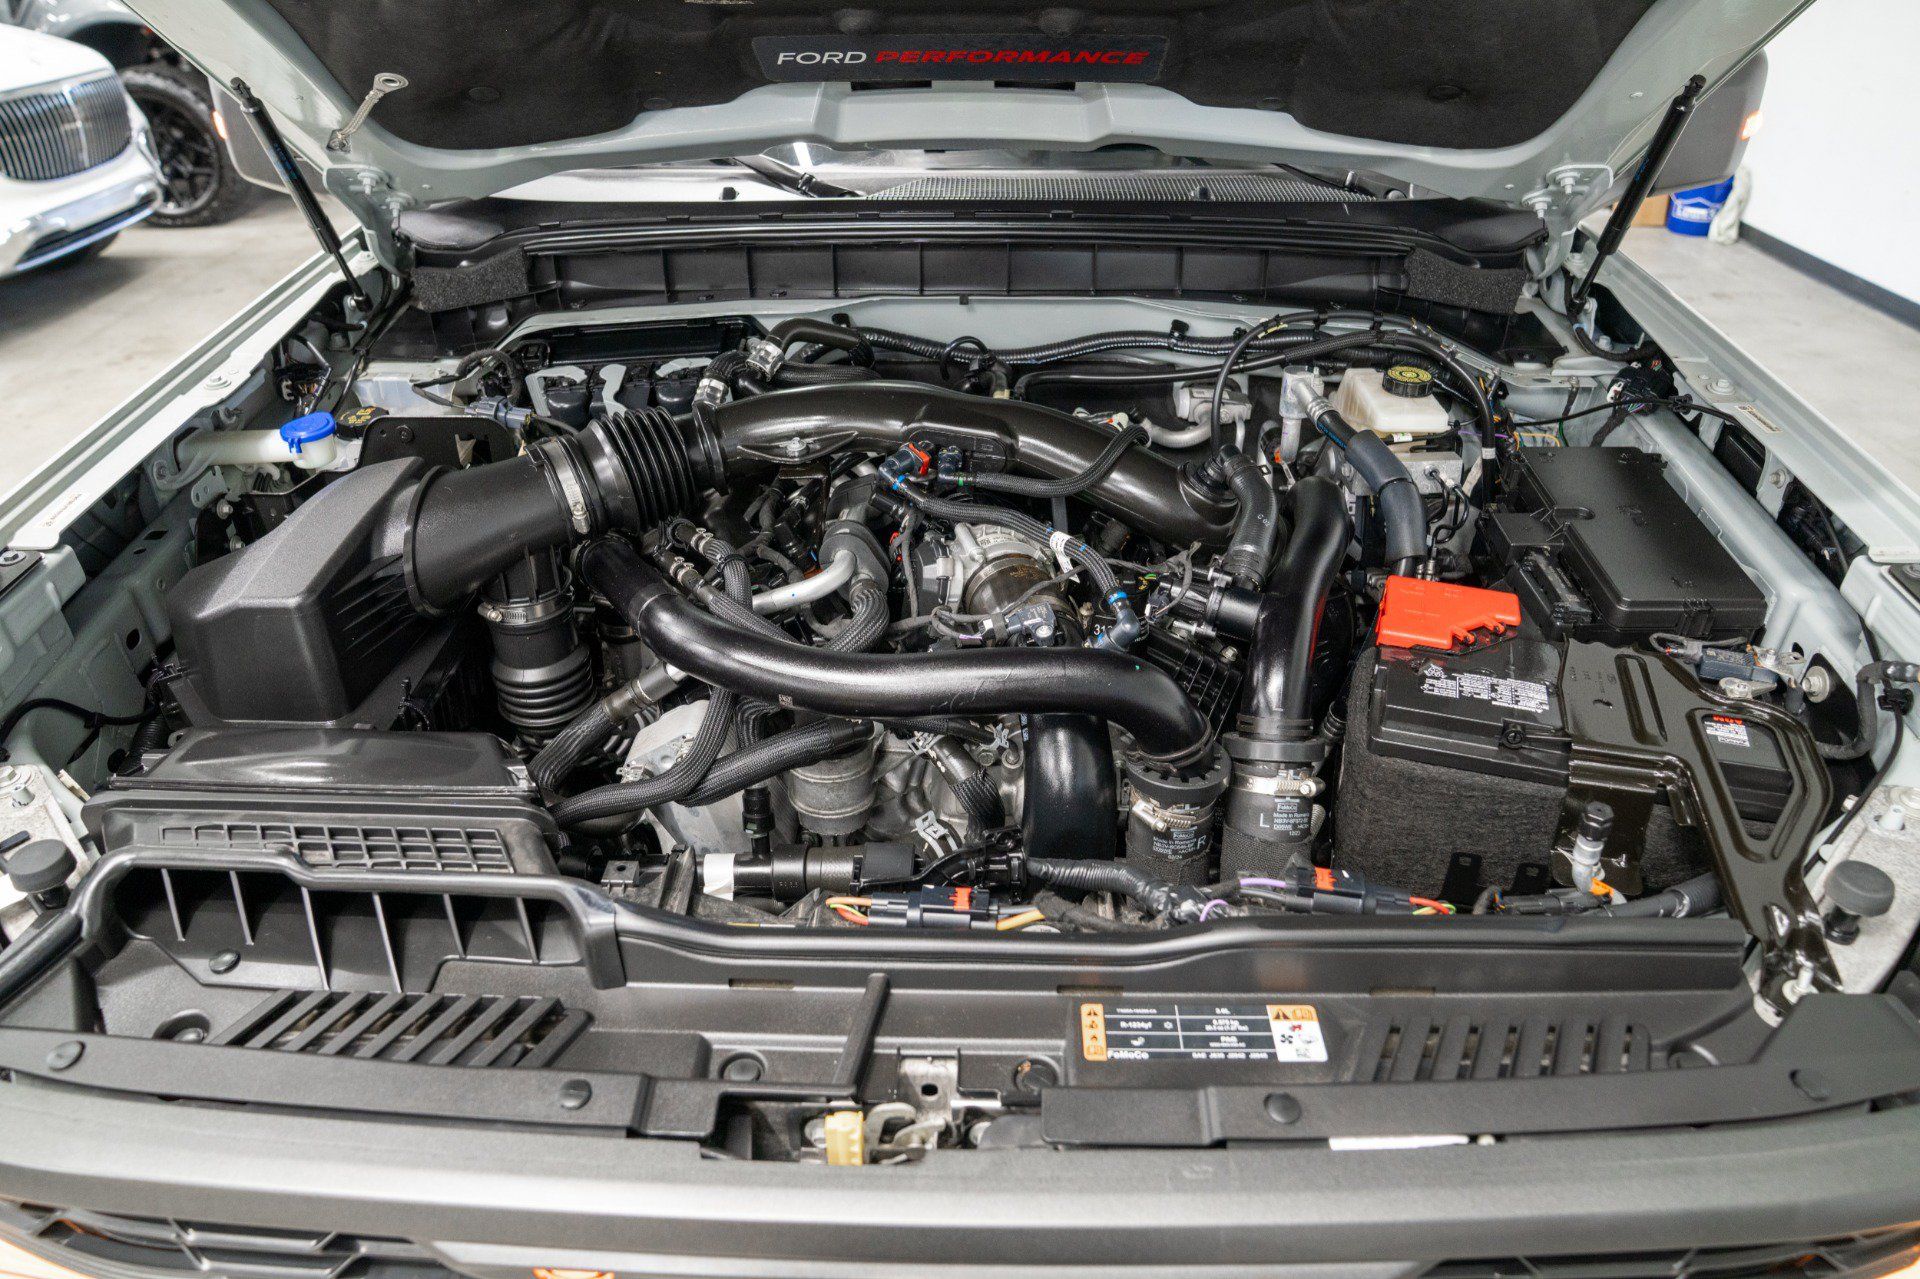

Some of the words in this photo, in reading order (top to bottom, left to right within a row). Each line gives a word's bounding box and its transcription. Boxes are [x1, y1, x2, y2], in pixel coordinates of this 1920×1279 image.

[777, 51, 867, 65] FORD
[874, 49, 1151, 66] PERFORMANCE
[1259, 813, 1270, 828] L
[1153, 836, 1168, 844] Made
[1197, 835, 1207, 849] R
[1107, 1050, 1150, 1060] FoMoCo
